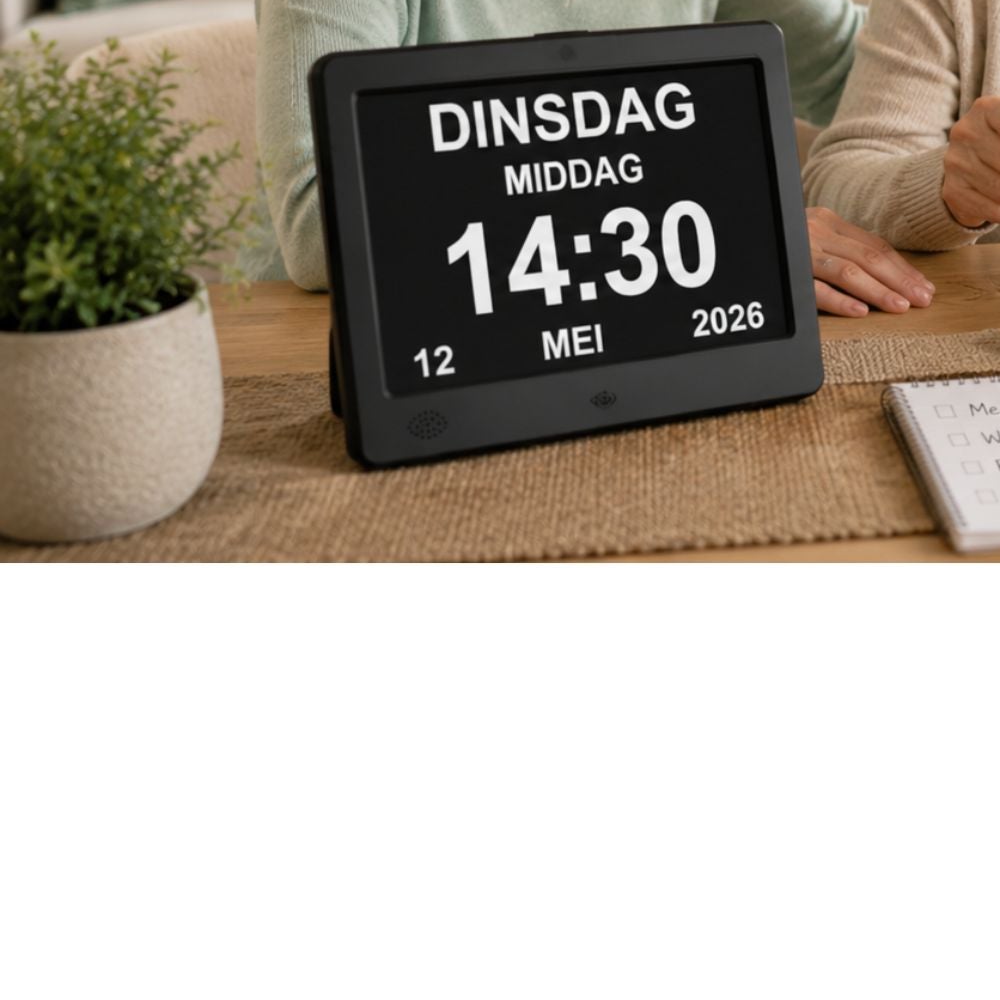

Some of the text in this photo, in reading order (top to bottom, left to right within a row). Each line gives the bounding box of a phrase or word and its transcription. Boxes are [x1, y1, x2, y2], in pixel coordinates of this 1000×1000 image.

[428, 82, 696, 152] DINSDAG
[504, 153, 644, 195] MIDDAG
[447, 200, 717, 316] 14:30
[413, 301, 765, 378] 12 MEI 2026
